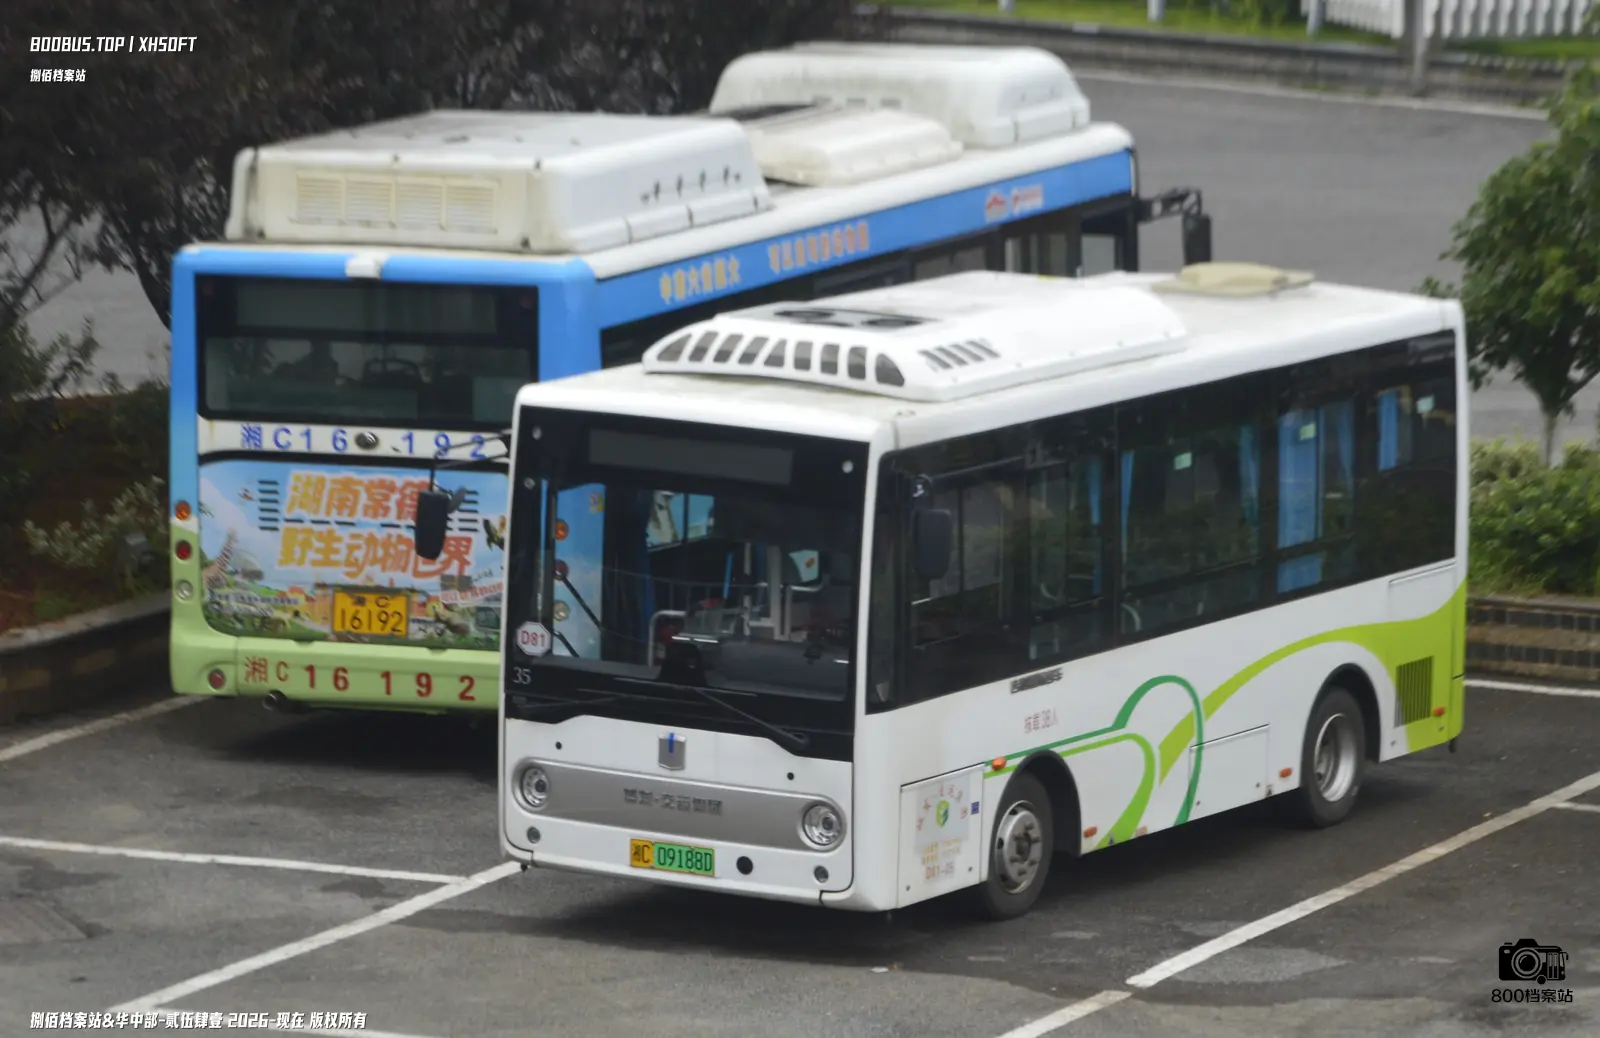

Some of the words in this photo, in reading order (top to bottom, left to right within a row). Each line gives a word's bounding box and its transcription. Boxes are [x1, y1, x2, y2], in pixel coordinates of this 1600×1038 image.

[341, 608, 404, 633] 16192
[521, 630, 546, 647] D81
[513, 666, 532, 685] 35
[657, 847, 712, 872] 09188D
